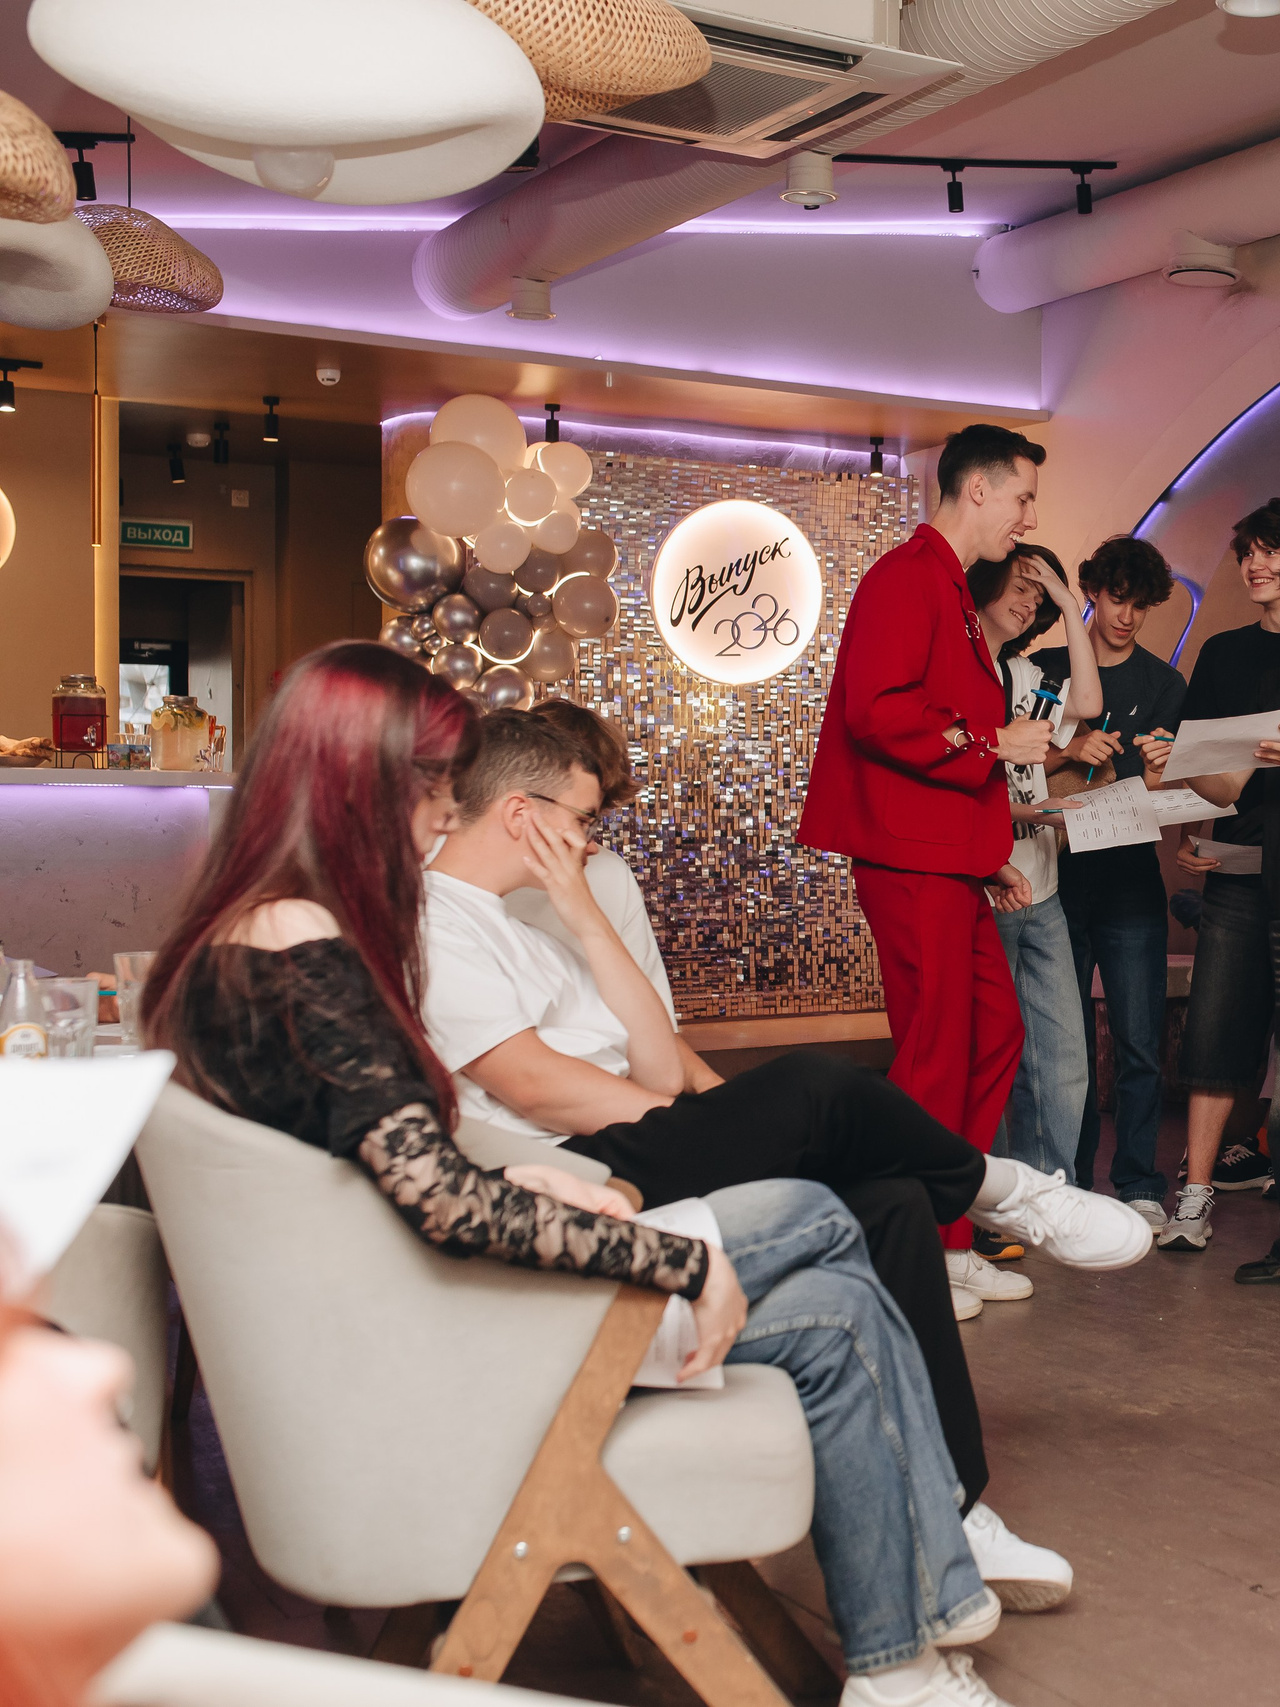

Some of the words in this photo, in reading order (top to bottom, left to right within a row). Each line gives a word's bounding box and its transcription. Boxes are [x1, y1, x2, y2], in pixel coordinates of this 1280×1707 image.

[126, 527, 184, 544] ВЫХОД
[670, 537, 791, 632] Выпуск
[714, 594, 799, 656] 2026
